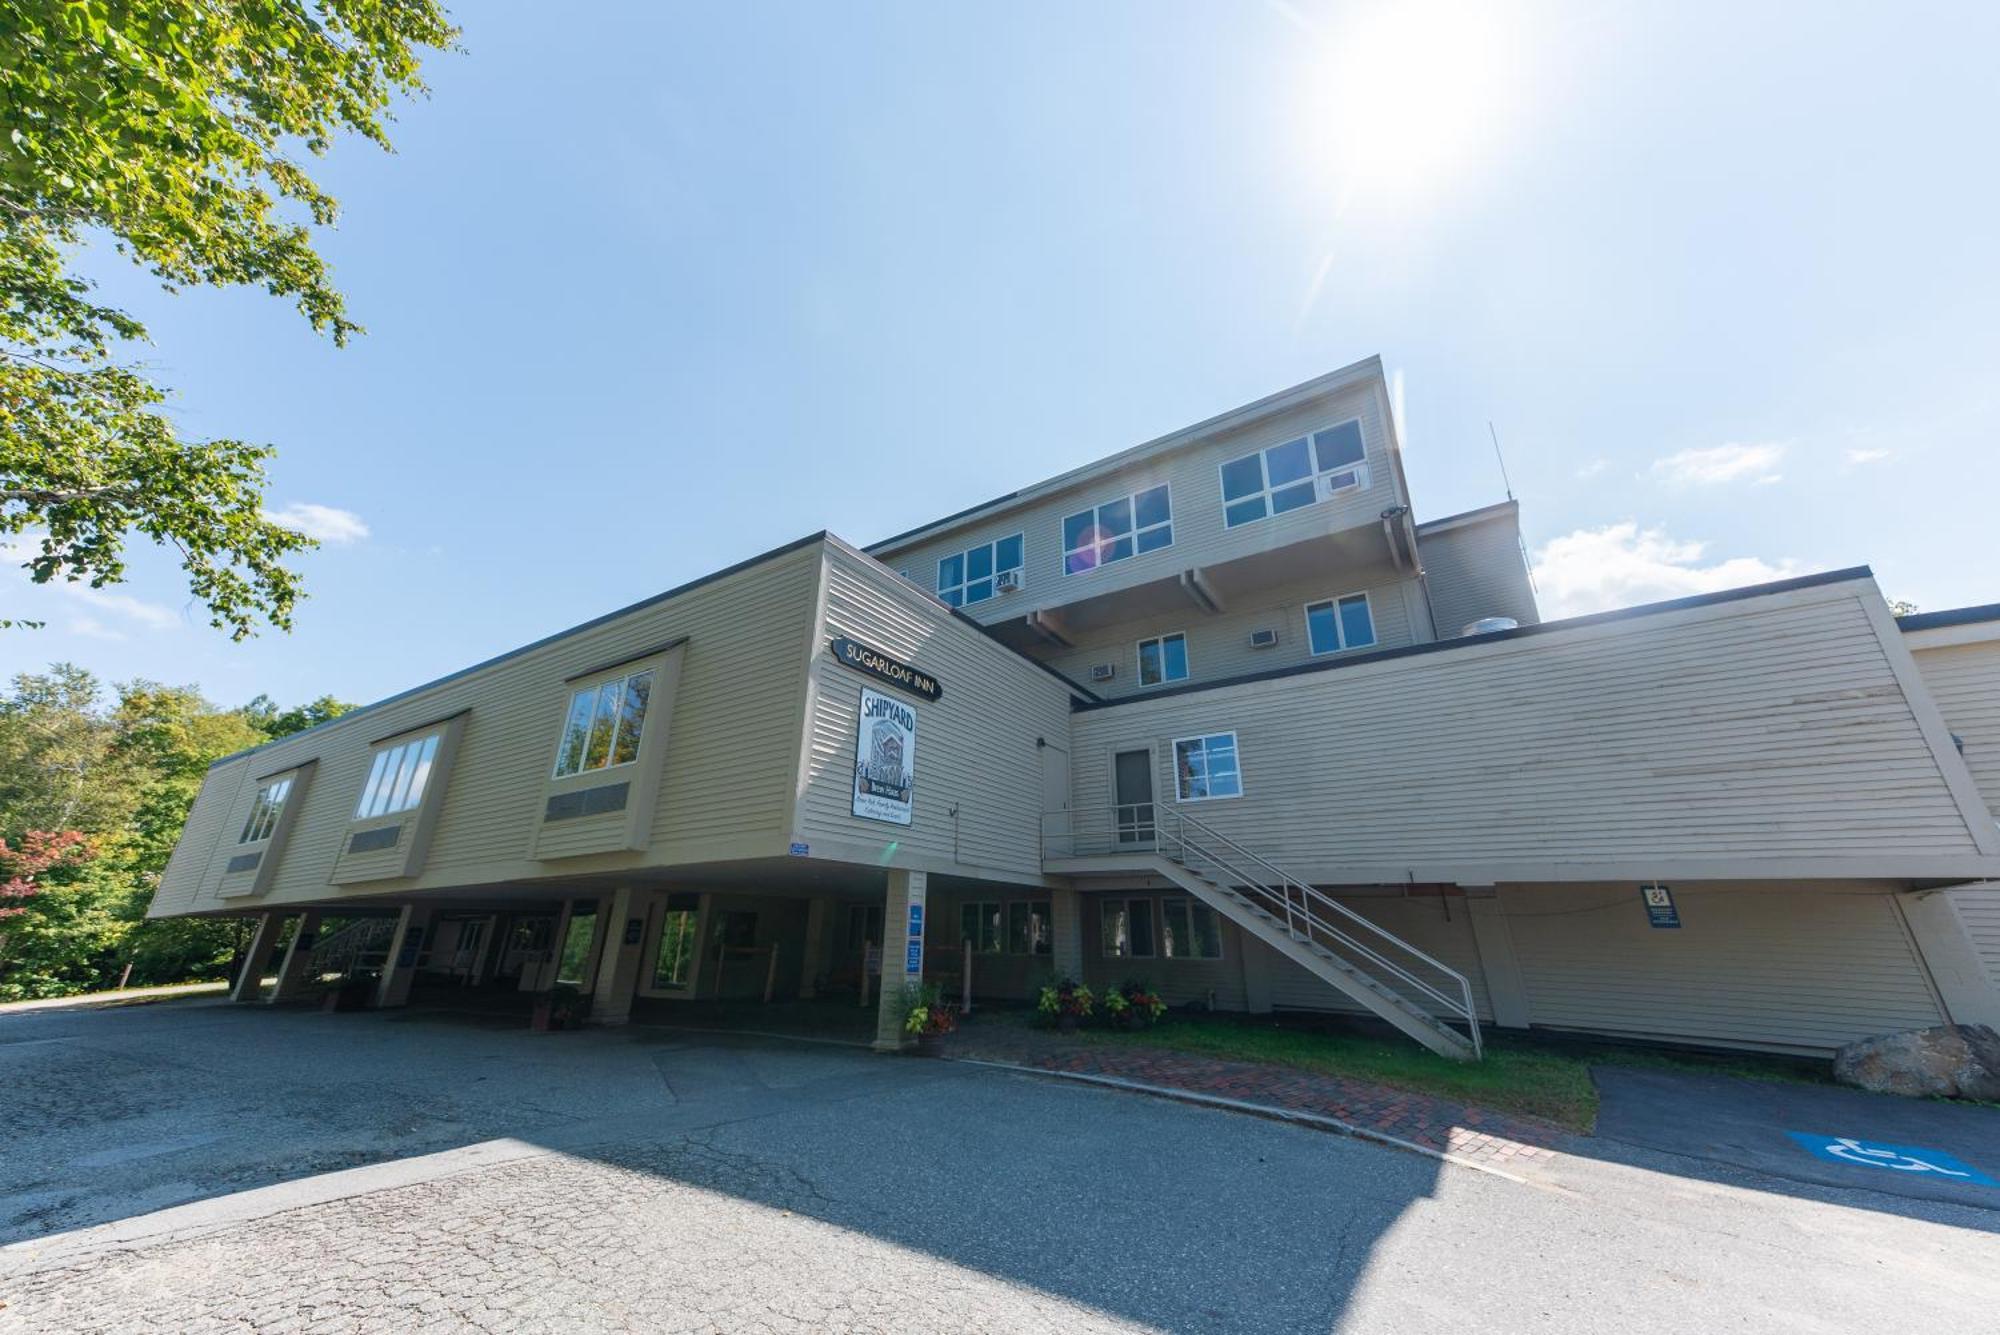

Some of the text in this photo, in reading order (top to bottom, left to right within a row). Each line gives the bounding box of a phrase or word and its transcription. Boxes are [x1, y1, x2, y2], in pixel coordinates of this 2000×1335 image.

[846, 643, 935, 694] SUGARLOAF INN
[864, 696, 914, 732] SHIPYARD
